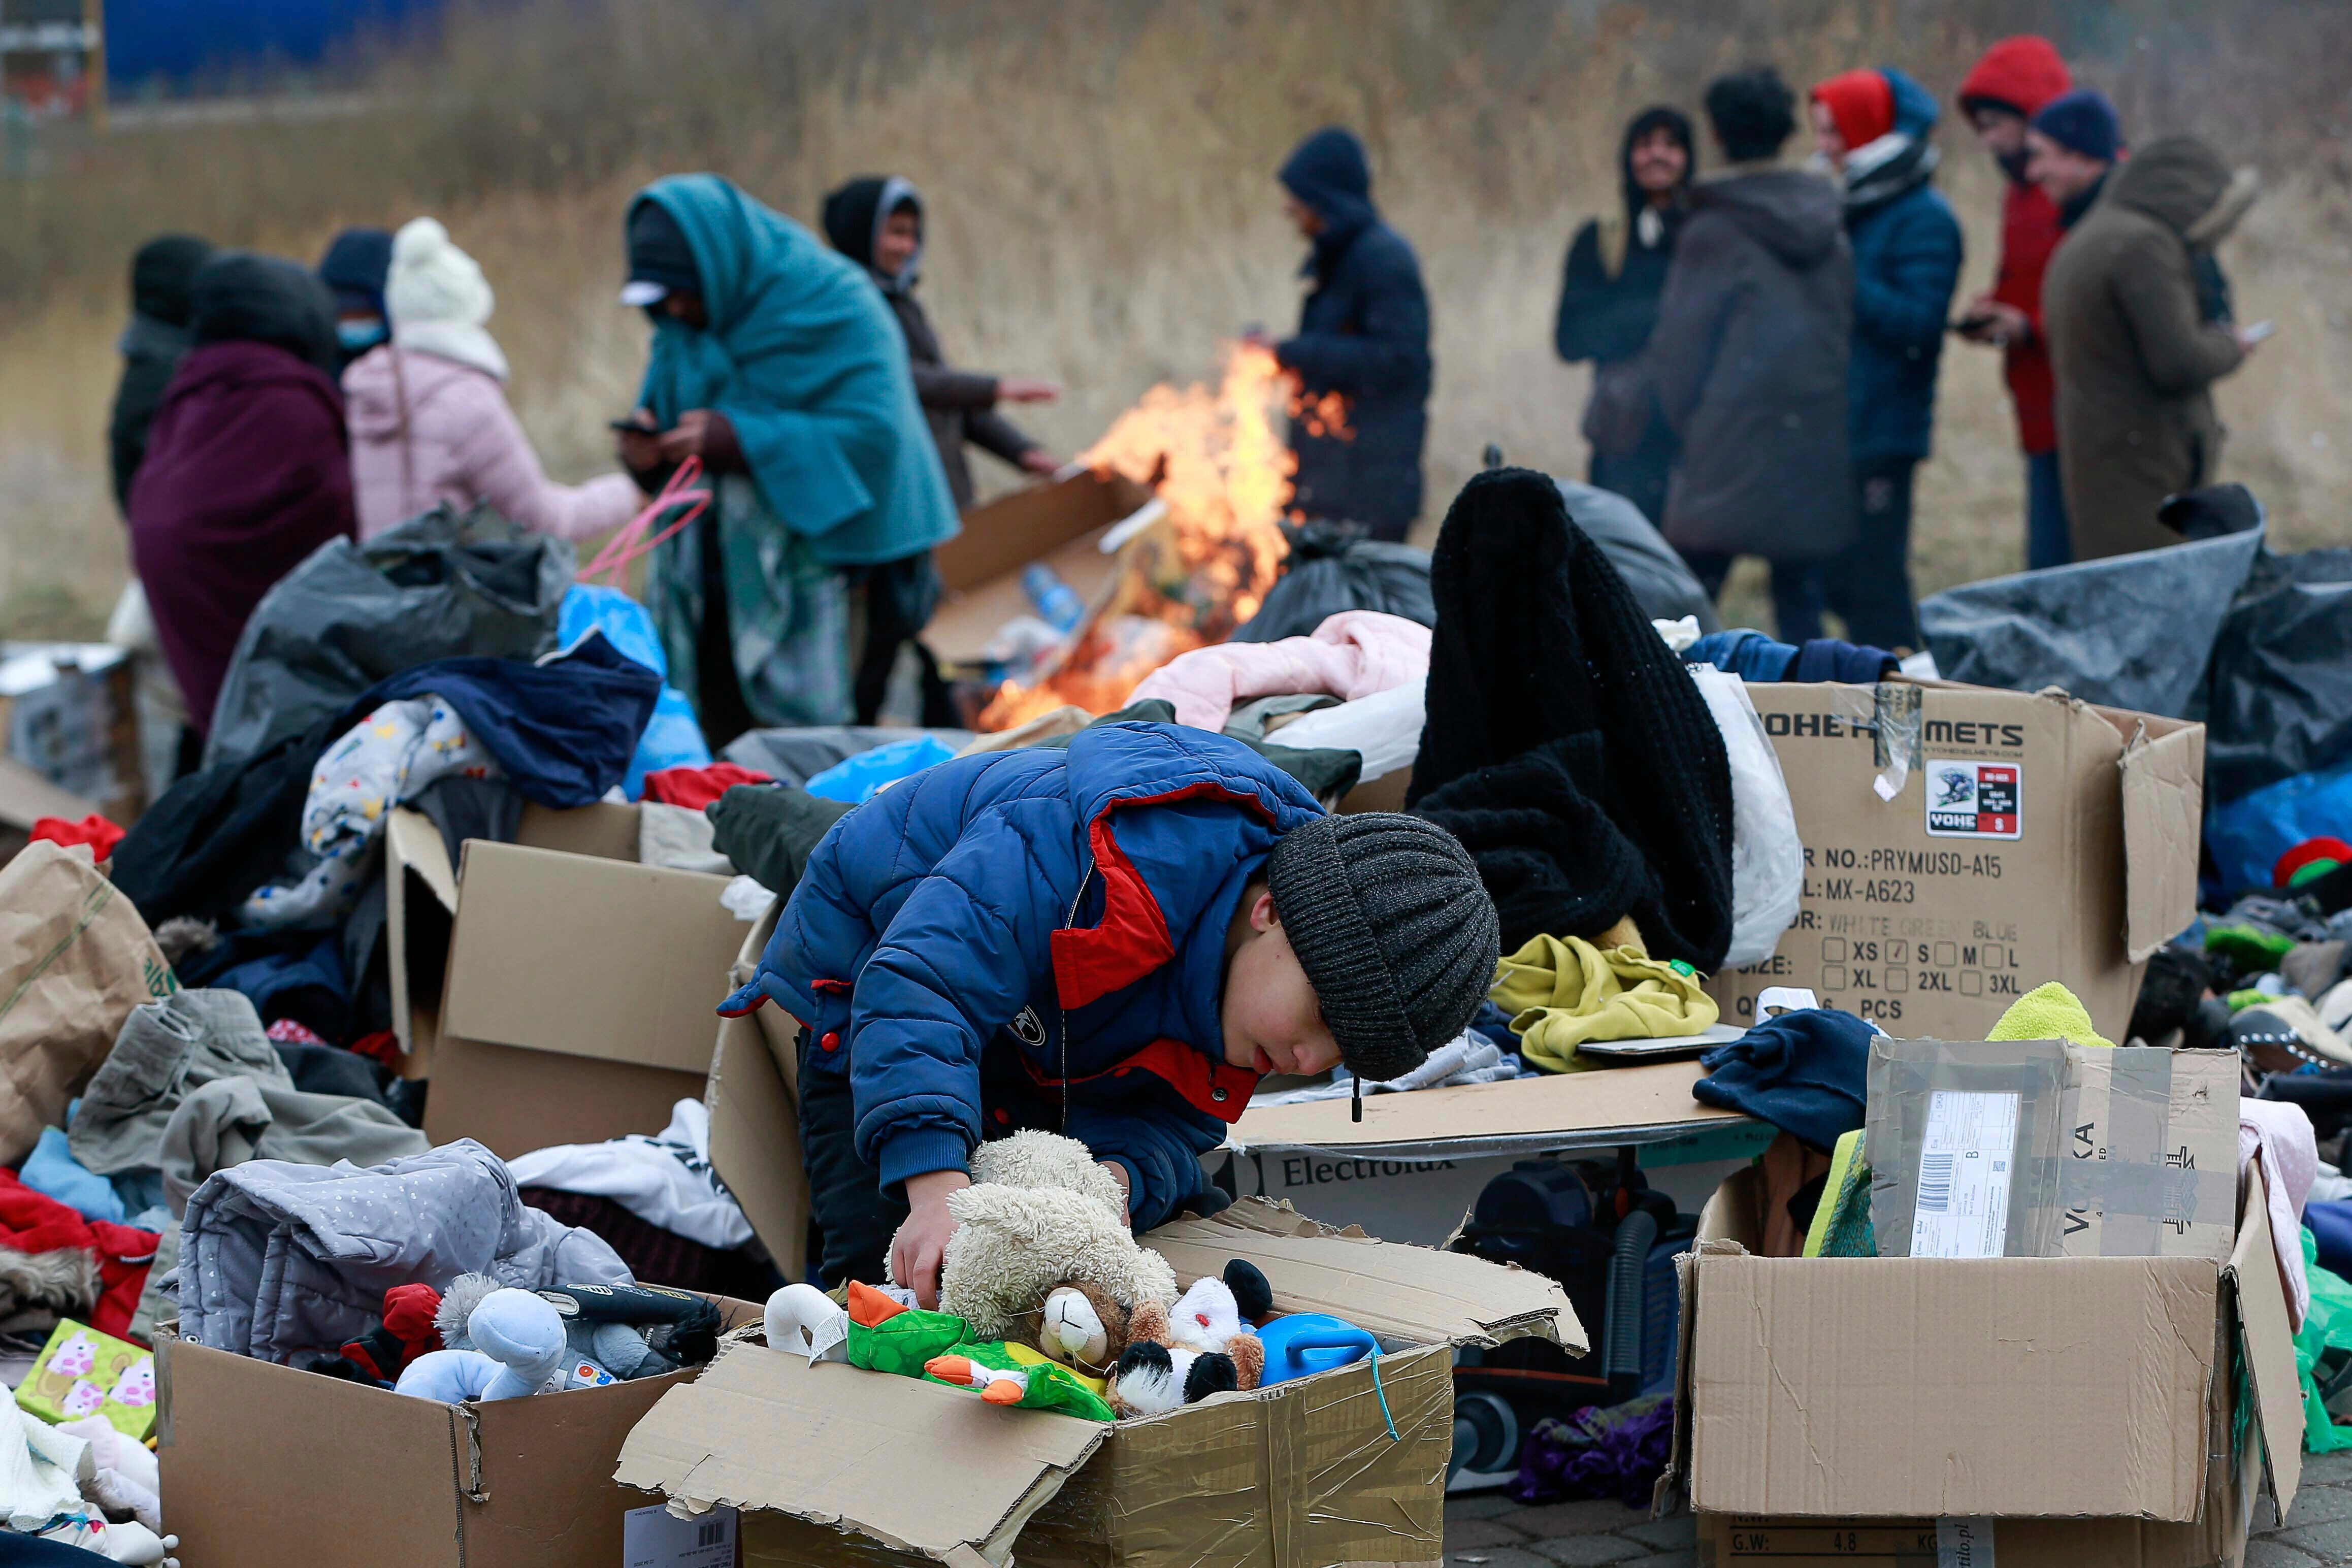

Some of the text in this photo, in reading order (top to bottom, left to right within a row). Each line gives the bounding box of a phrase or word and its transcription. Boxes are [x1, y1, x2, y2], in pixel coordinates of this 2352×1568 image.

[1758, 713, 1844, 738] OHE
[1931, 813, 1977, 828] YOHE
[1994, 817, 2005, 832] S
[1973, 920, 2018, 941] BLUE
[1853, 941, 2019, 967] XS S M L
[1853, 968, 2020, 995] XL 2XL 3XL
[1860, 1000, 1902, 1019] PCS
[1732, 1532, 1770, 1551] G.W:
[1833, 1531, 1857, 1552] 4.8
